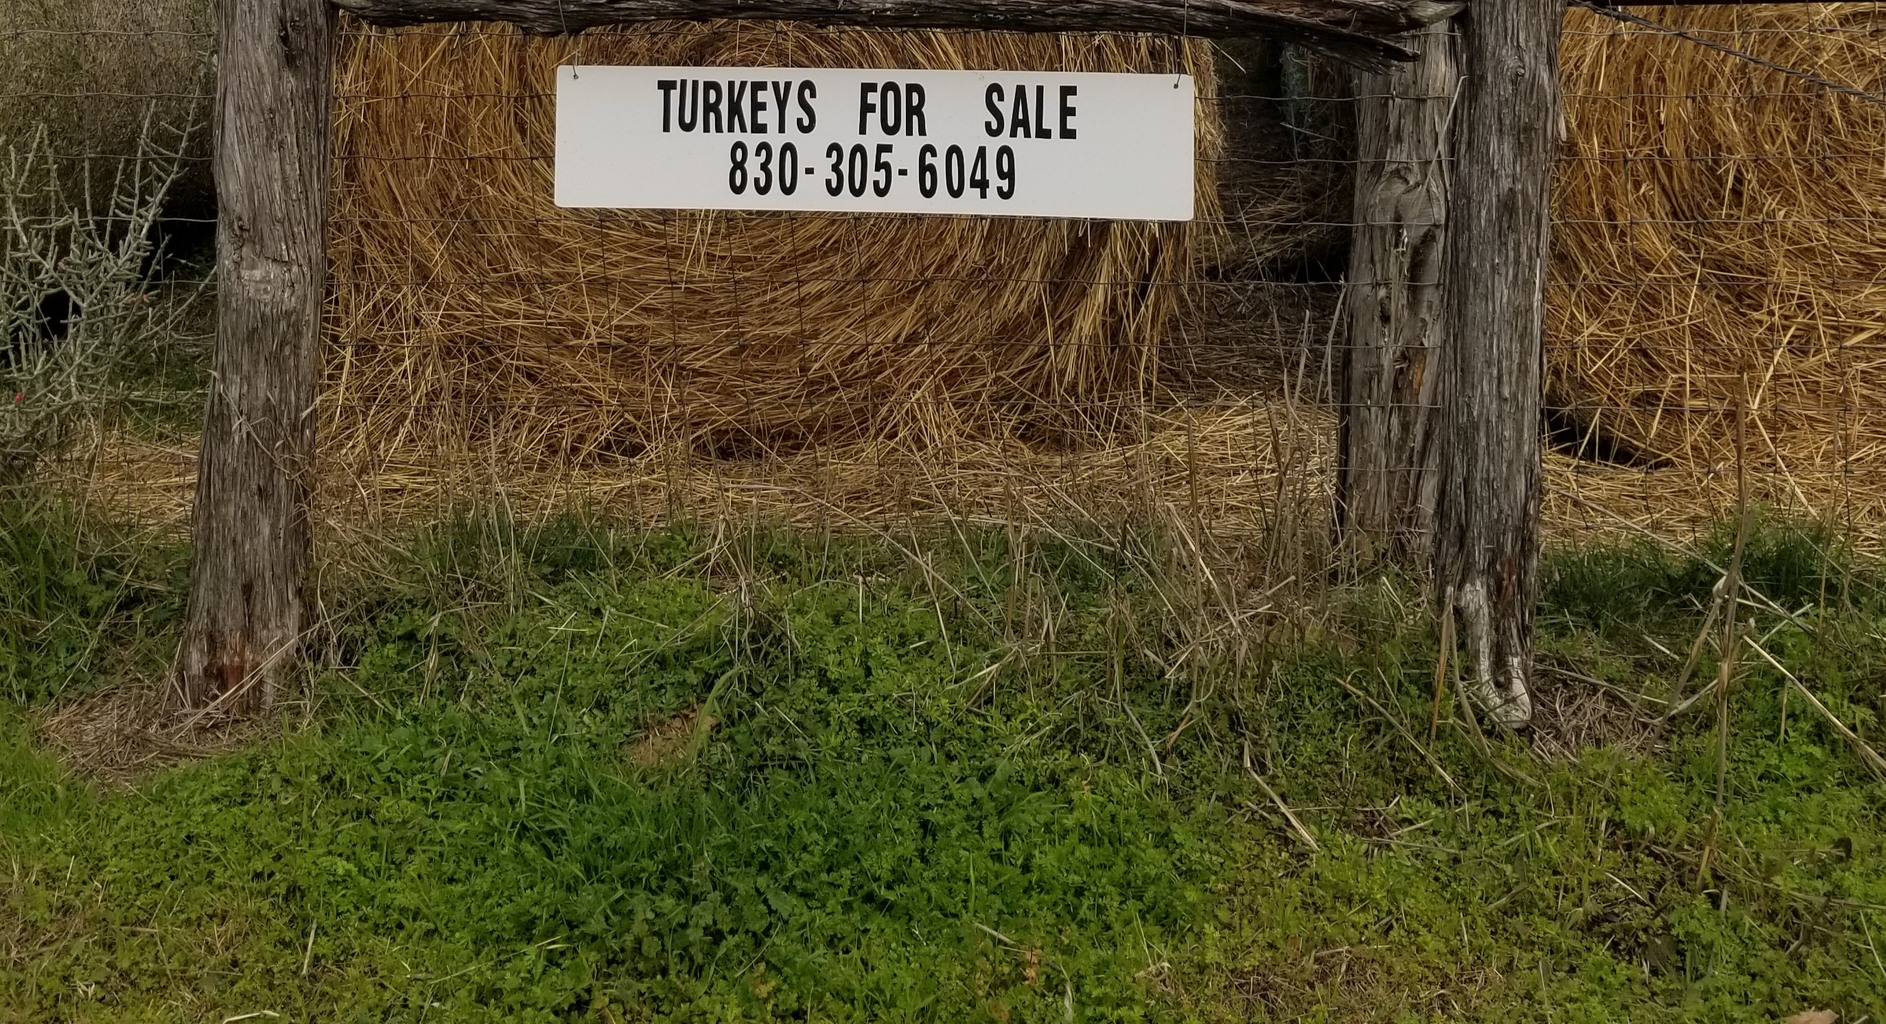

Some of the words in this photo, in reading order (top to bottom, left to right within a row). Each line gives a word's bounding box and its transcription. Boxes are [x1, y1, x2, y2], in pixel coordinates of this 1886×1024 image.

[657, 79, 817, 134] TURKEYS
[858, 81, 927, 137] FOR
[984, 83, 1078, 140] SALE
[728, 140, 1016, 201] 830-305-6049
